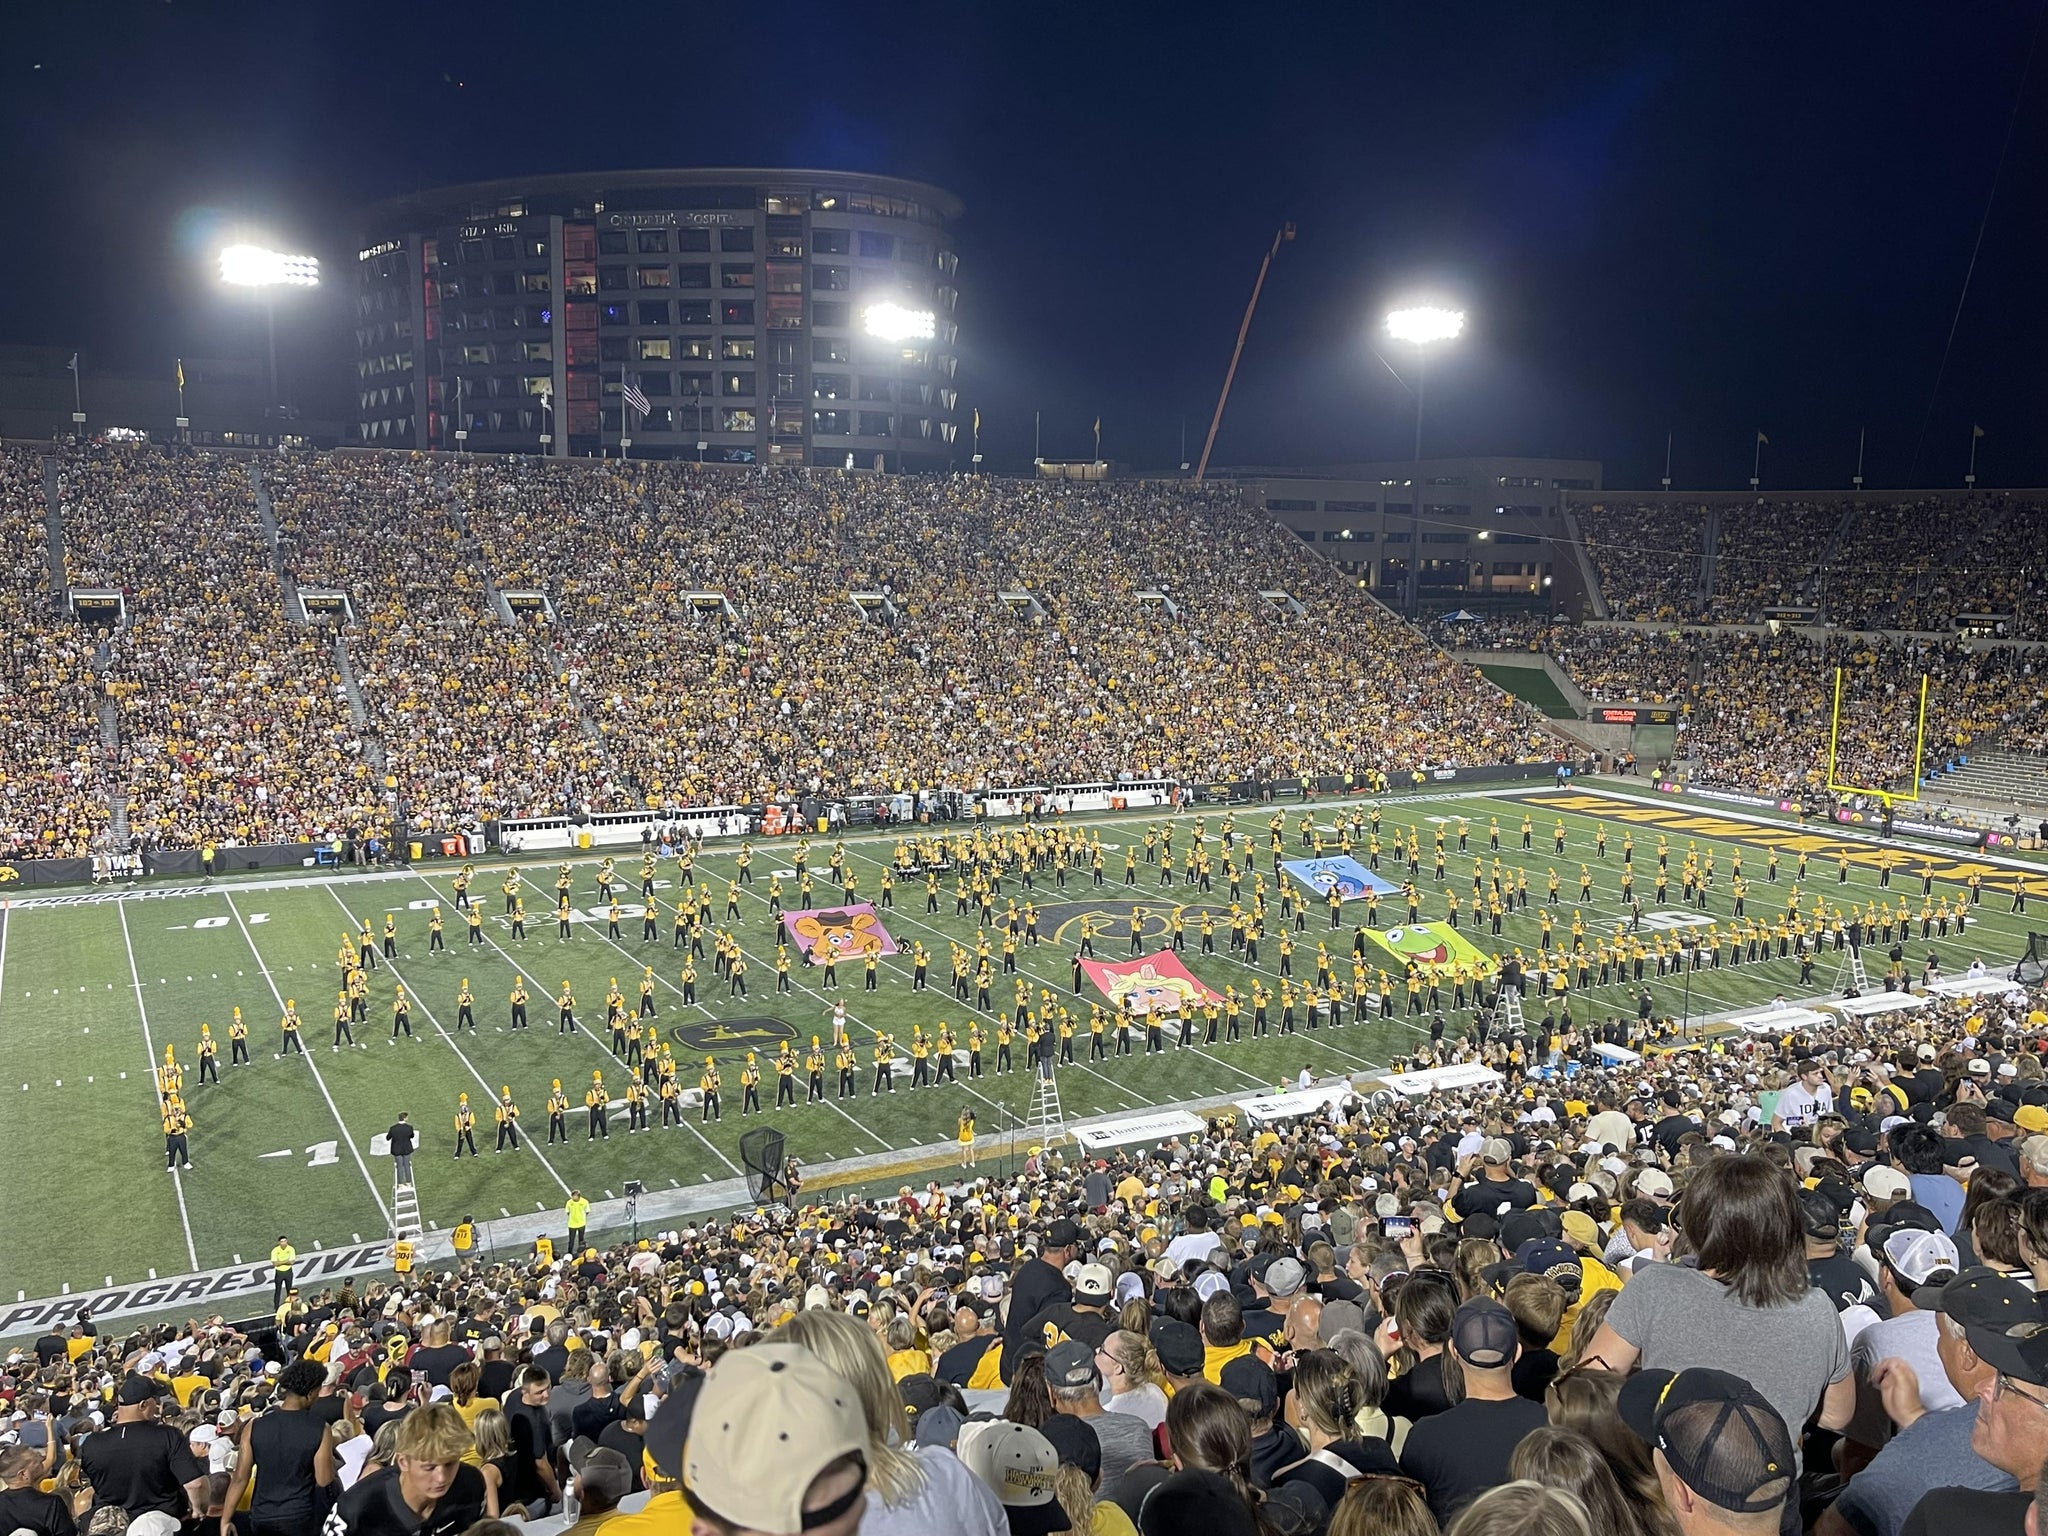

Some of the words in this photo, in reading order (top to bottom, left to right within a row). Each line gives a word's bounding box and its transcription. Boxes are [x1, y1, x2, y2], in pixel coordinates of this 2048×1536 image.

[1110, 1119, 1188, 1137] Homemakers
[1640, 1125, 1654, 1142] 15
[0, 1245, 388, 1333] PROGRESIVE
